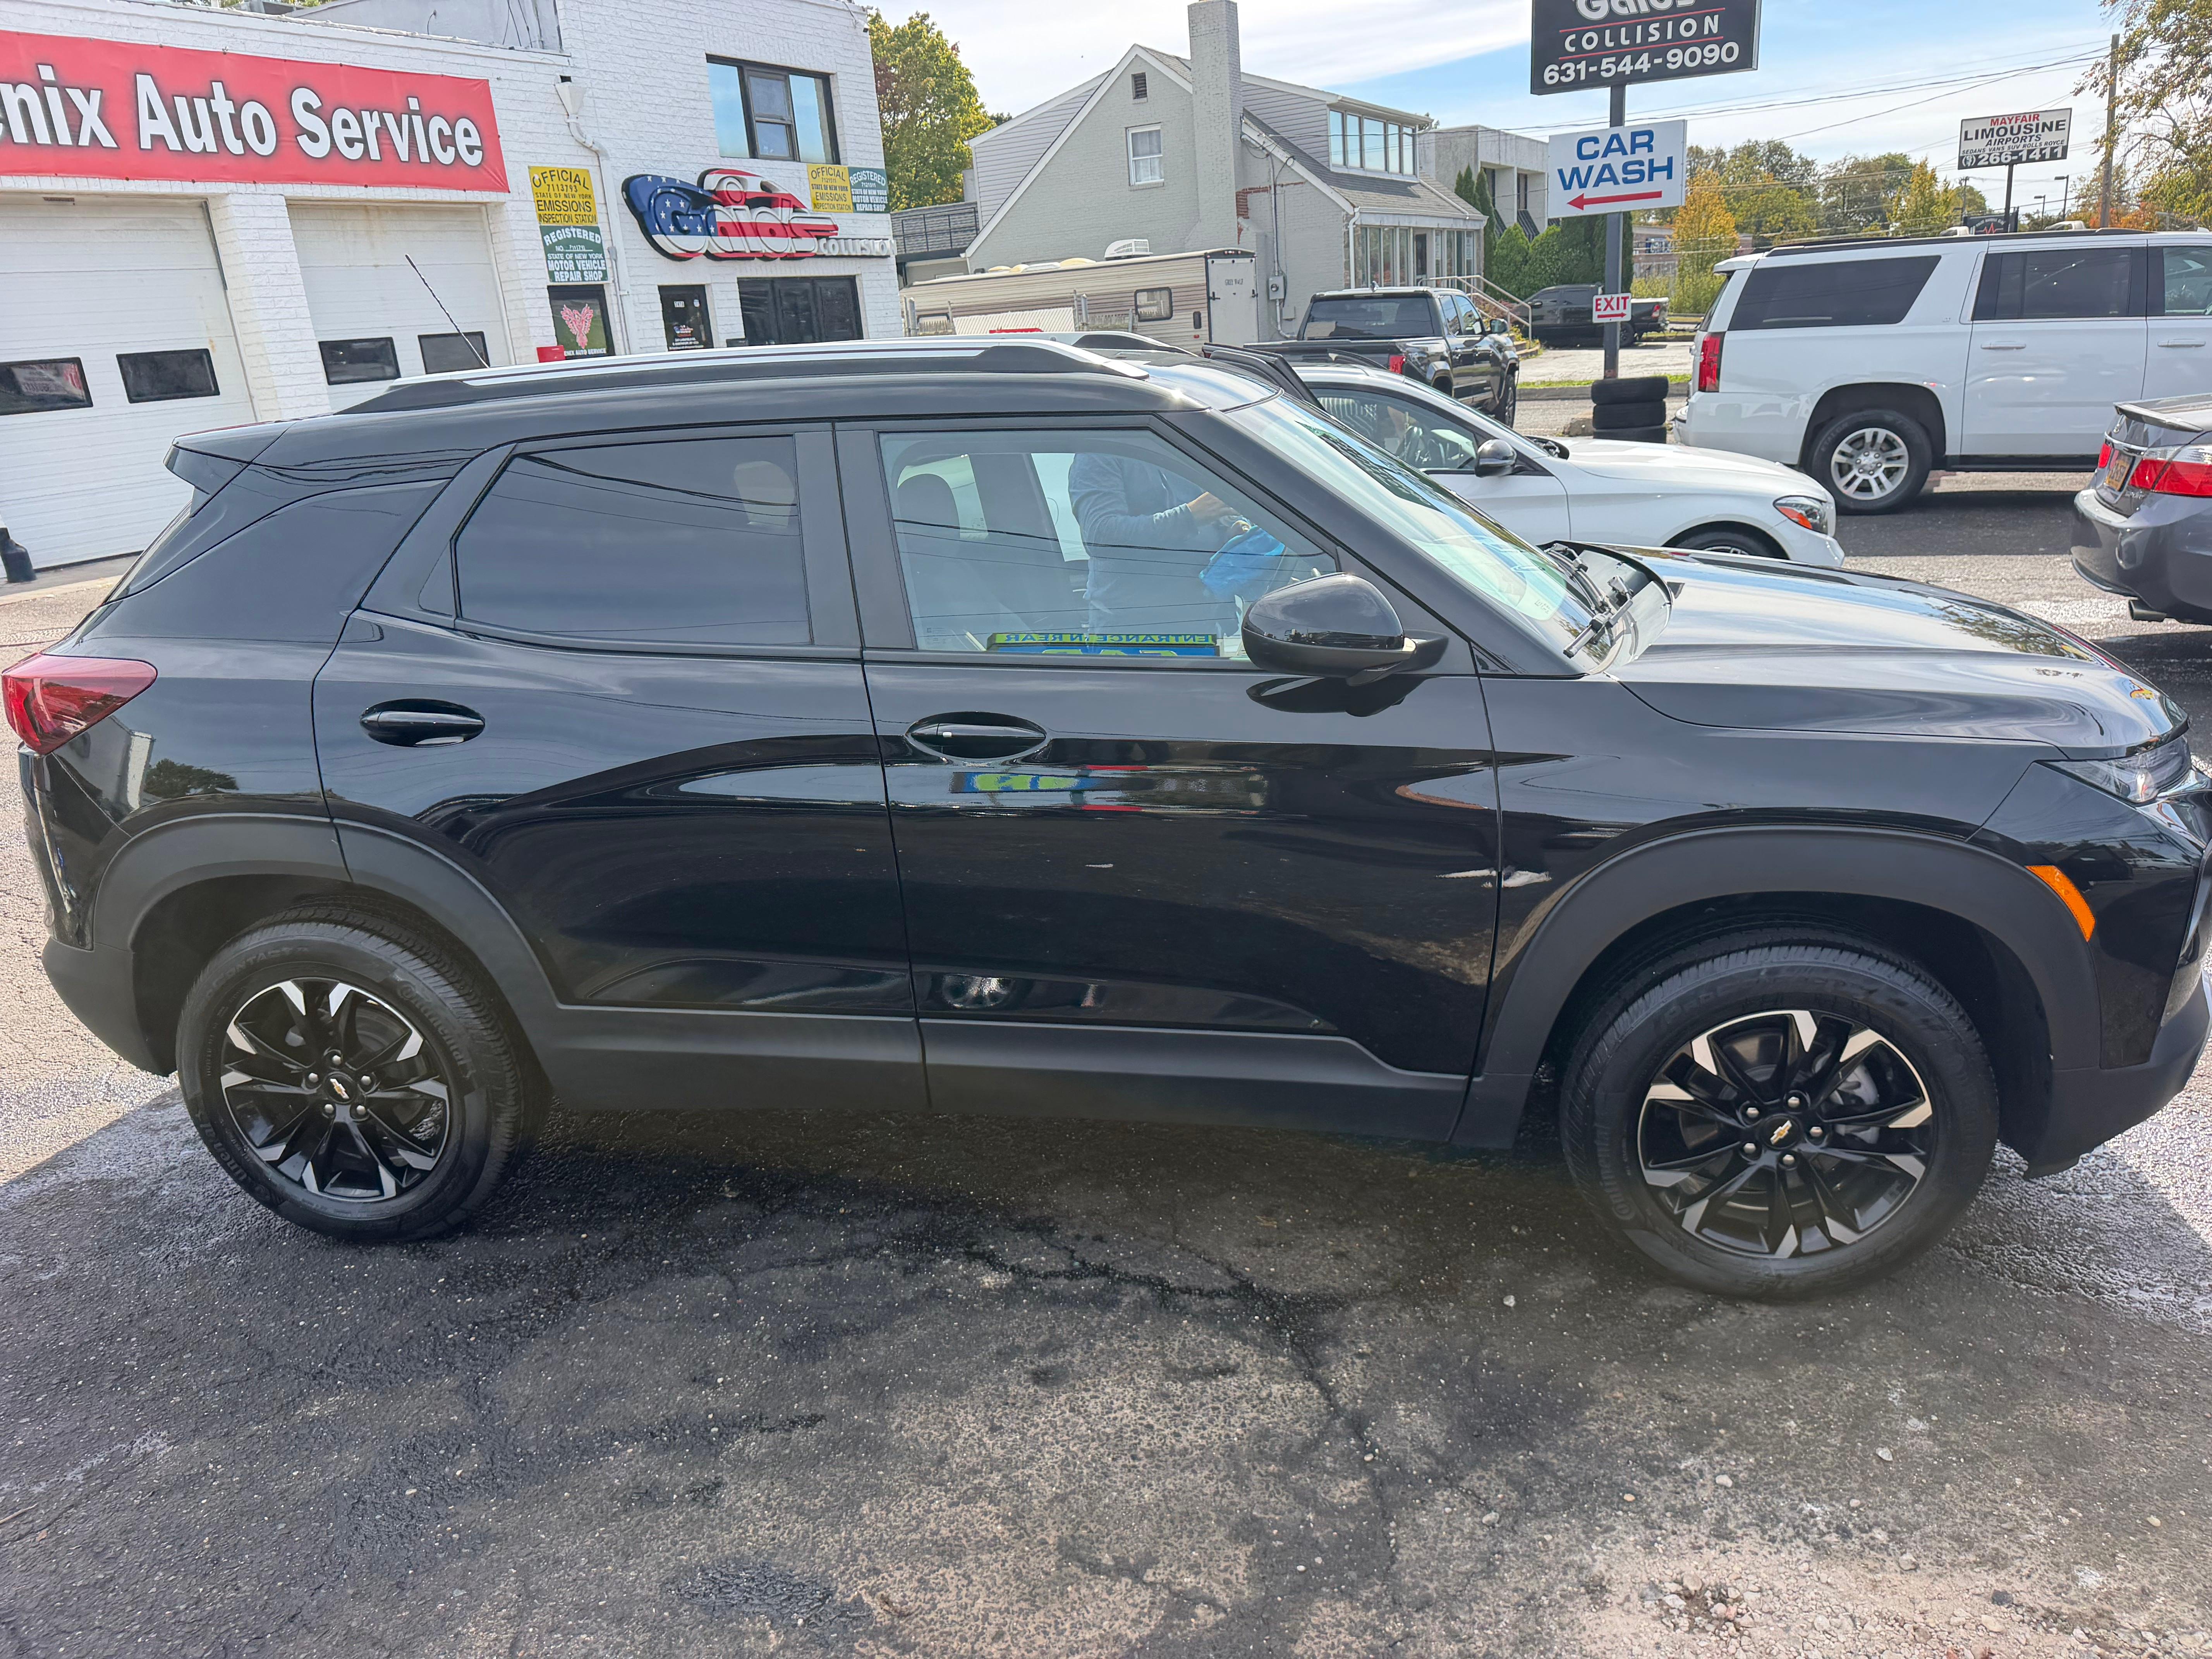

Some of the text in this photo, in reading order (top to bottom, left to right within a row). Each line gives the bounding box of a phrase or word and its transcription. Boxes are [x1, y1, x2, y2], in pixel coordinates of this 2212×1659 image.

[1565, 14, 1719, 52] COLLISION
[1544, 41, 1739, 84] 631-544-9090
[0, 64, 483, 166] nix Auto Service
[1990, 113, 2040, 126] MAYFAIR
[1964, 119, 2066, 141] LIMOUSINE
[1577, 129, 1654, 160] CAR
[1985, 134, 2042, 147] AIRPORTS
[532, 170, 589, 190] OFFICIAL
[811, 167, 845, 181] OFFICIAL
[850, 170, 886, 186] REGISTERED
[1558, 156, 1673, 191] WASH
[816, 192, 847, 202] EMISSIONS
[536, 200, 591, 212] EMISSIONS
[539, 213, 596, 223] INSPECTION STATION
[543, 228, 601, 246] REGISTERED
[818, 237, 898, 256] COLLISION
[547, 260, 606, 271] MOTOR VEHICLE
[554, 271, 603, 282] REPAIR SHOP
[1595, 296, 1629, 311] EXIT
